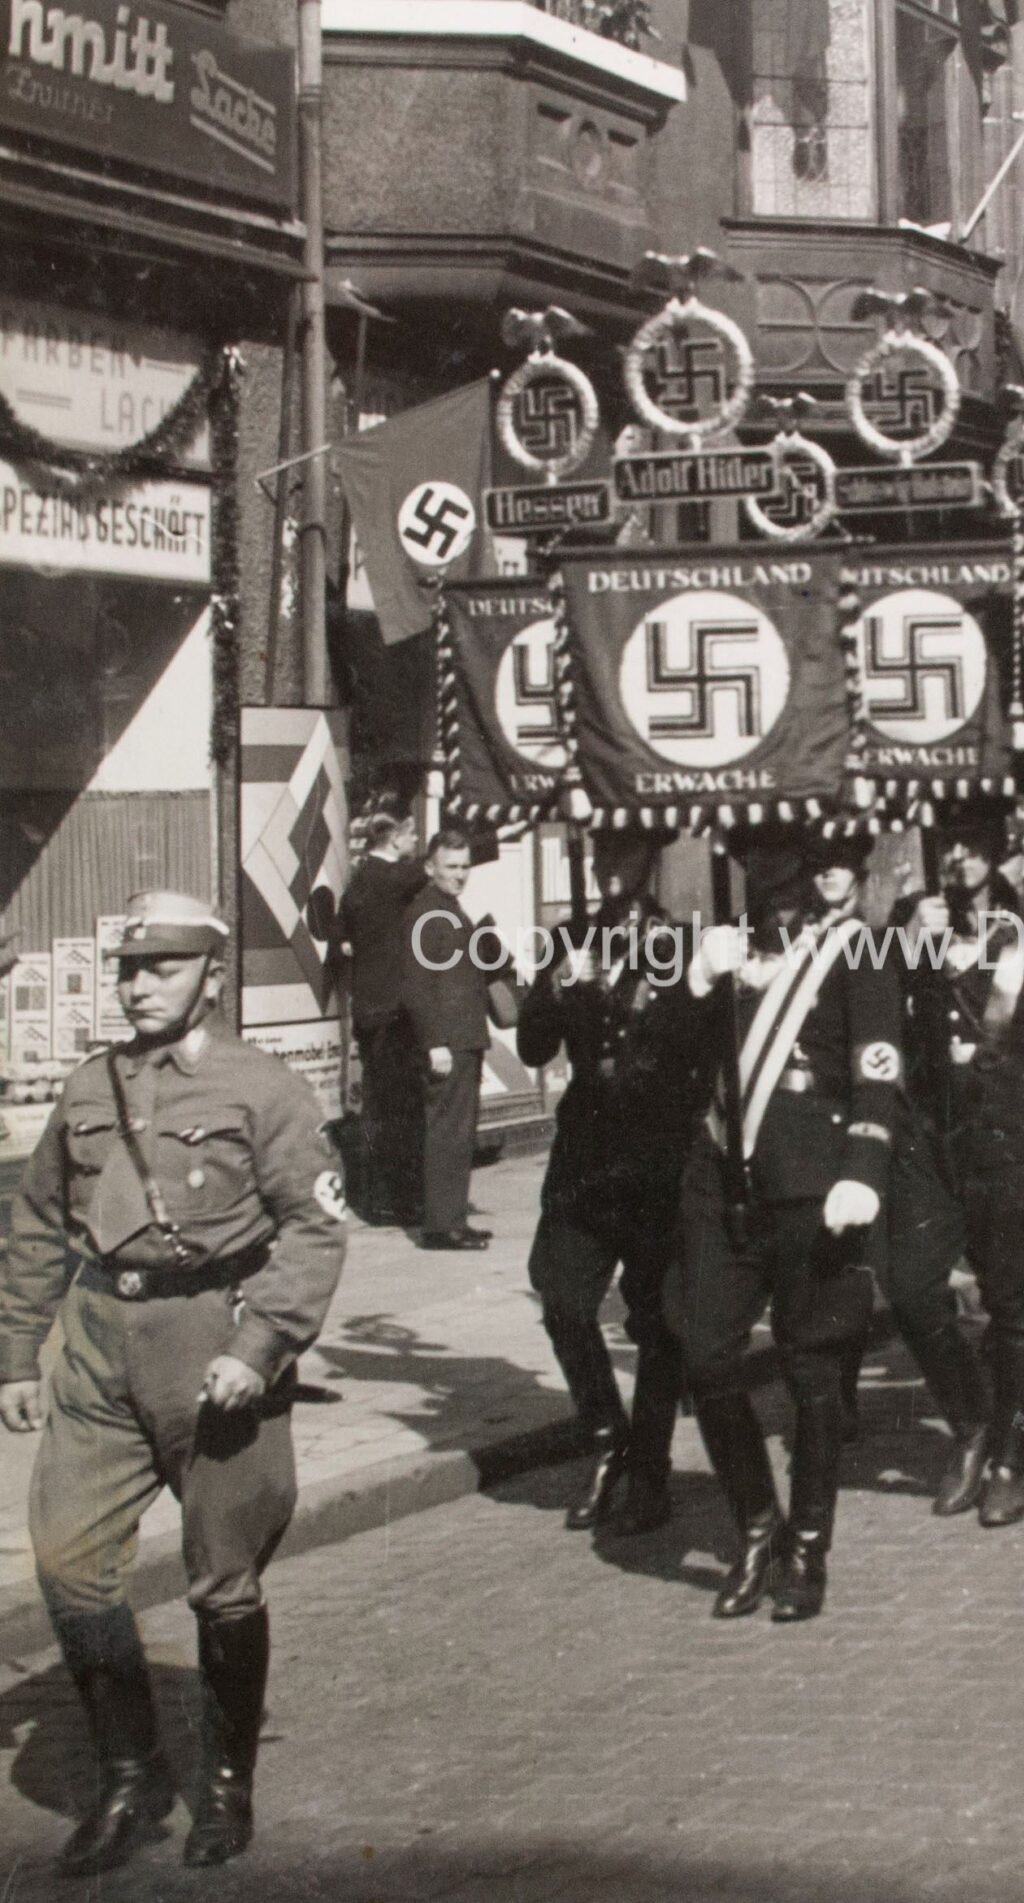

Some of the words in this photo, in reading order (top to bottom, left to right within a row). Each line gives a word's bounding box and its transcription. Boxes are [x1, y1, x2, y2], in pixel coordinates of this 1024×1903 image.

[625, 460, 692, 494] Adolf
[699, 456, 769, 490] Hitler
[588, 562, 812, 593] DEUTSCHLAND
[635, 769, 777, 793] ERWACHE
